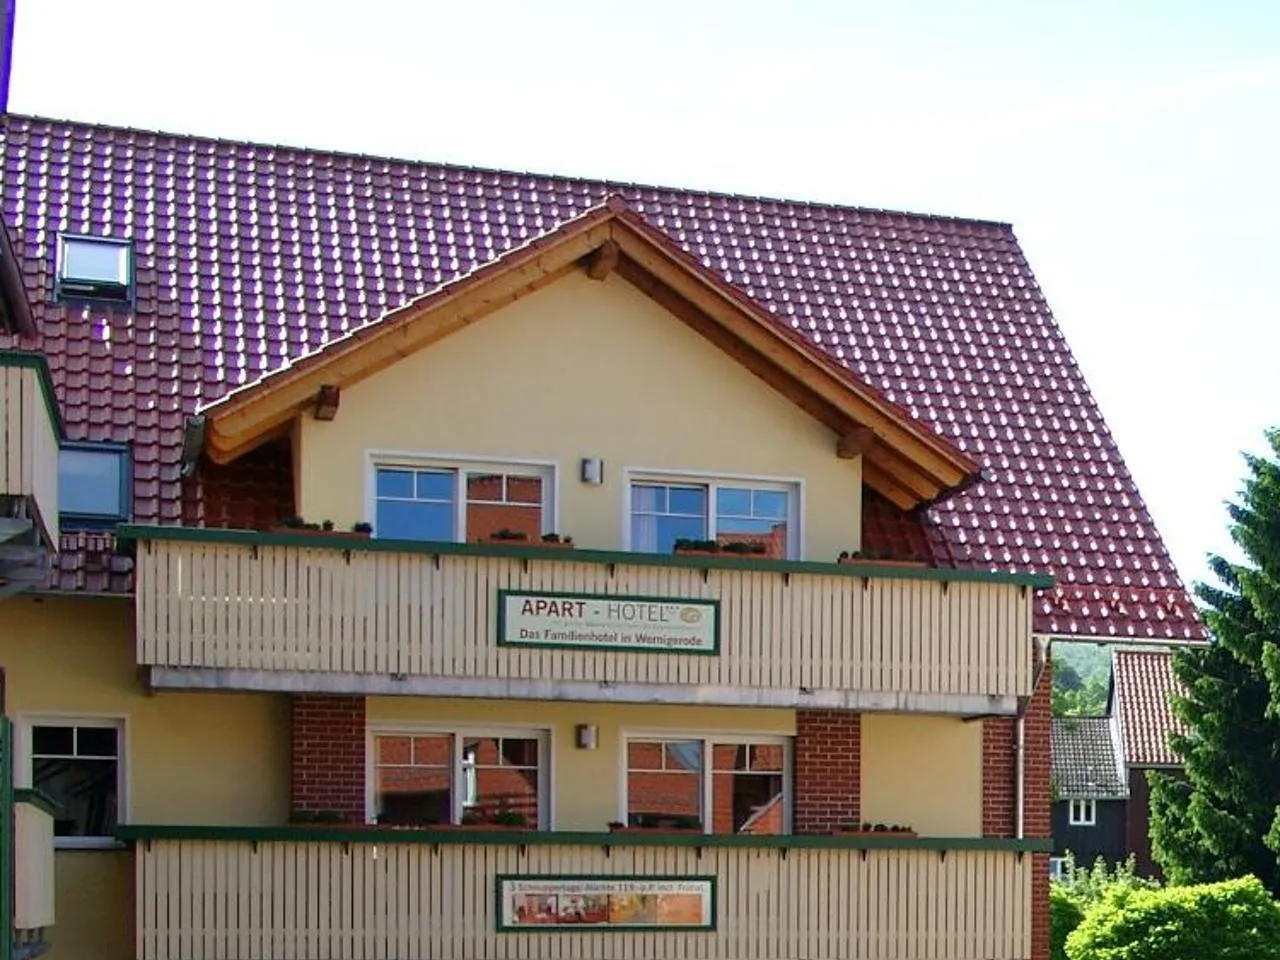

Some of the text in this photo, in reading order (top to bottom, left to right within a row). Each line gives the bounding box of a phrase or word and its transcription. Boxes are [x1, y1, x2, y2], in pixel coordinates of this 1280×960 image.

[521, 599, 586, 618] APART
[607, 603, 669, 622] HOTEL
[519, 628, 703, 649] Das Familienhotel in Wernigerode
